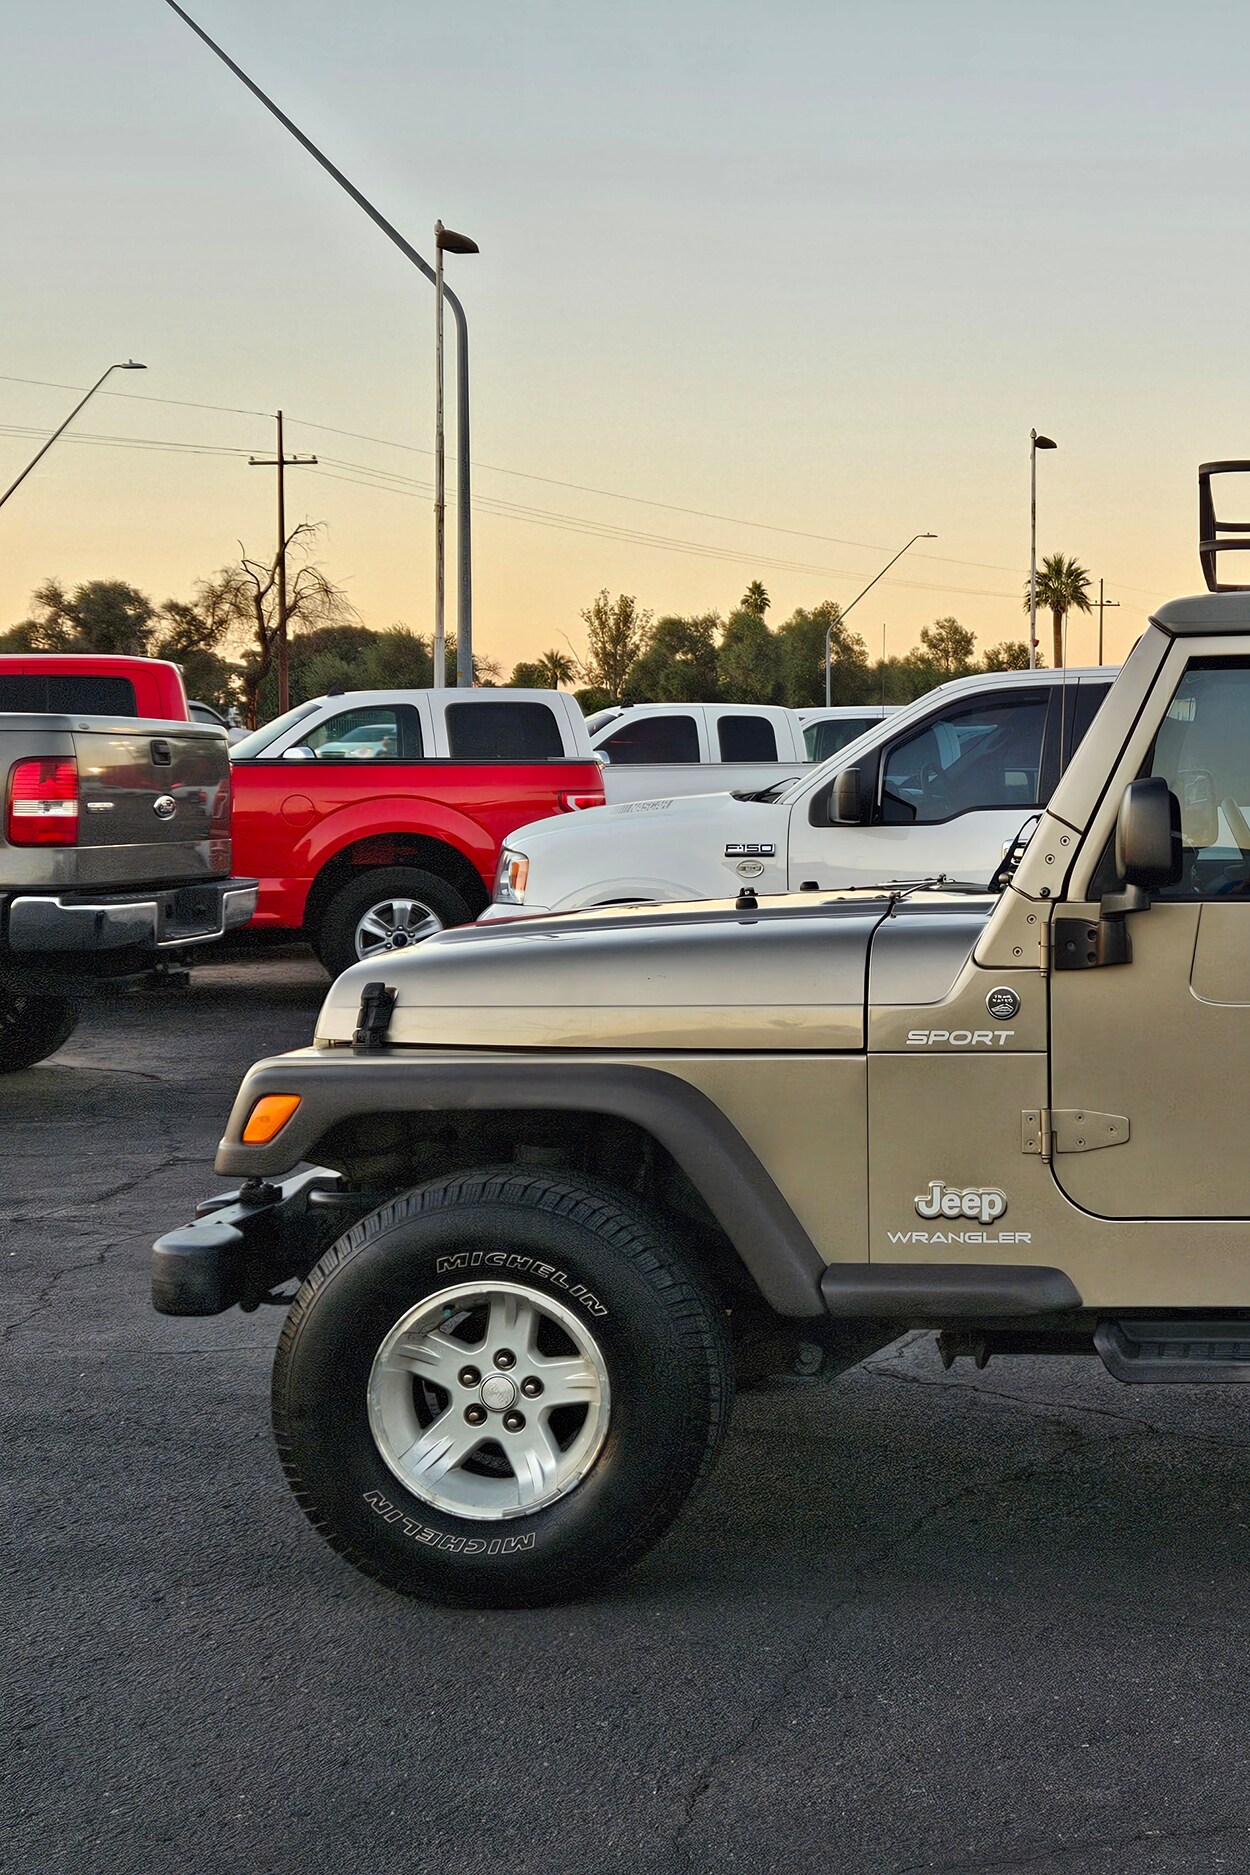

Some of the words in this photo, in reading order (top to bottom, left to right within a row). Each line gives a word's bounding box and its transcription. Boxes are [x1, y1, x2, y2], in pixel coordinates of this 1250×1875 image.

[905, 1030, 1015, 1046] SPORT
[915, 1183, 1005, 1223] Jeep
[886, 1231, 1032, 1244] WRANGLER
[436, 1252, 608, 1317] MICHELIN
[363, 1490, 536, 1555] MICHELIN
